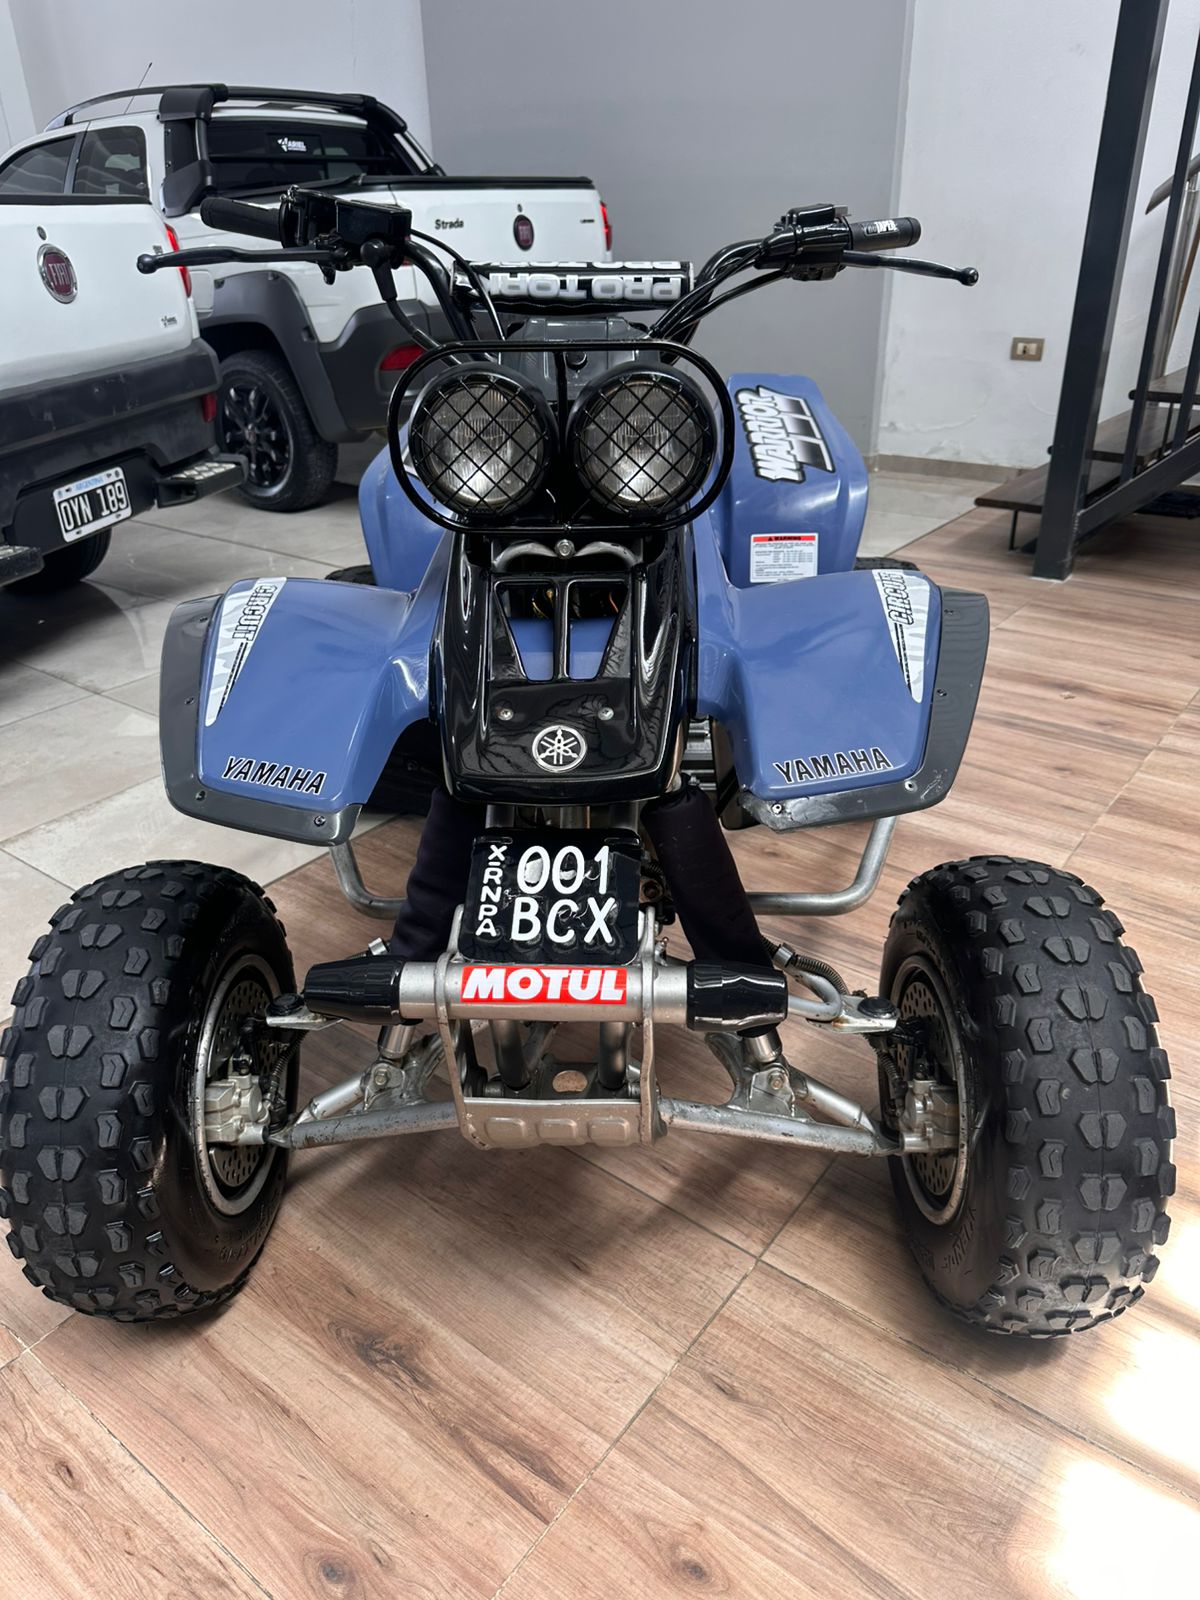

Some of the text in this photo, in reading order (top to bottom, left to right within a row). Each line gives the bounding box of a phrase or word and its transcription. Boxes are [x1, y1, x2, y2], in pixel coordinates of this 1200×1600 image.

[435, 218, 464, 230] Strada
[48, 262, 73, 286] FIAT
[592, 275, 682, 300] PRO
[736, 386, 804, 483] WARRIOR
[96, 481, 128, 516] 189
[231, 584, 279, 642] CIRCUIT
[221, 756, 328, 795] YAMAHA
[775, 746, 894, 784] YAMAHA
[517, 845, 610, 895] 001
[511, 896, 616, 944] BCX
[462, 968, 626, 1001] MOTUL
